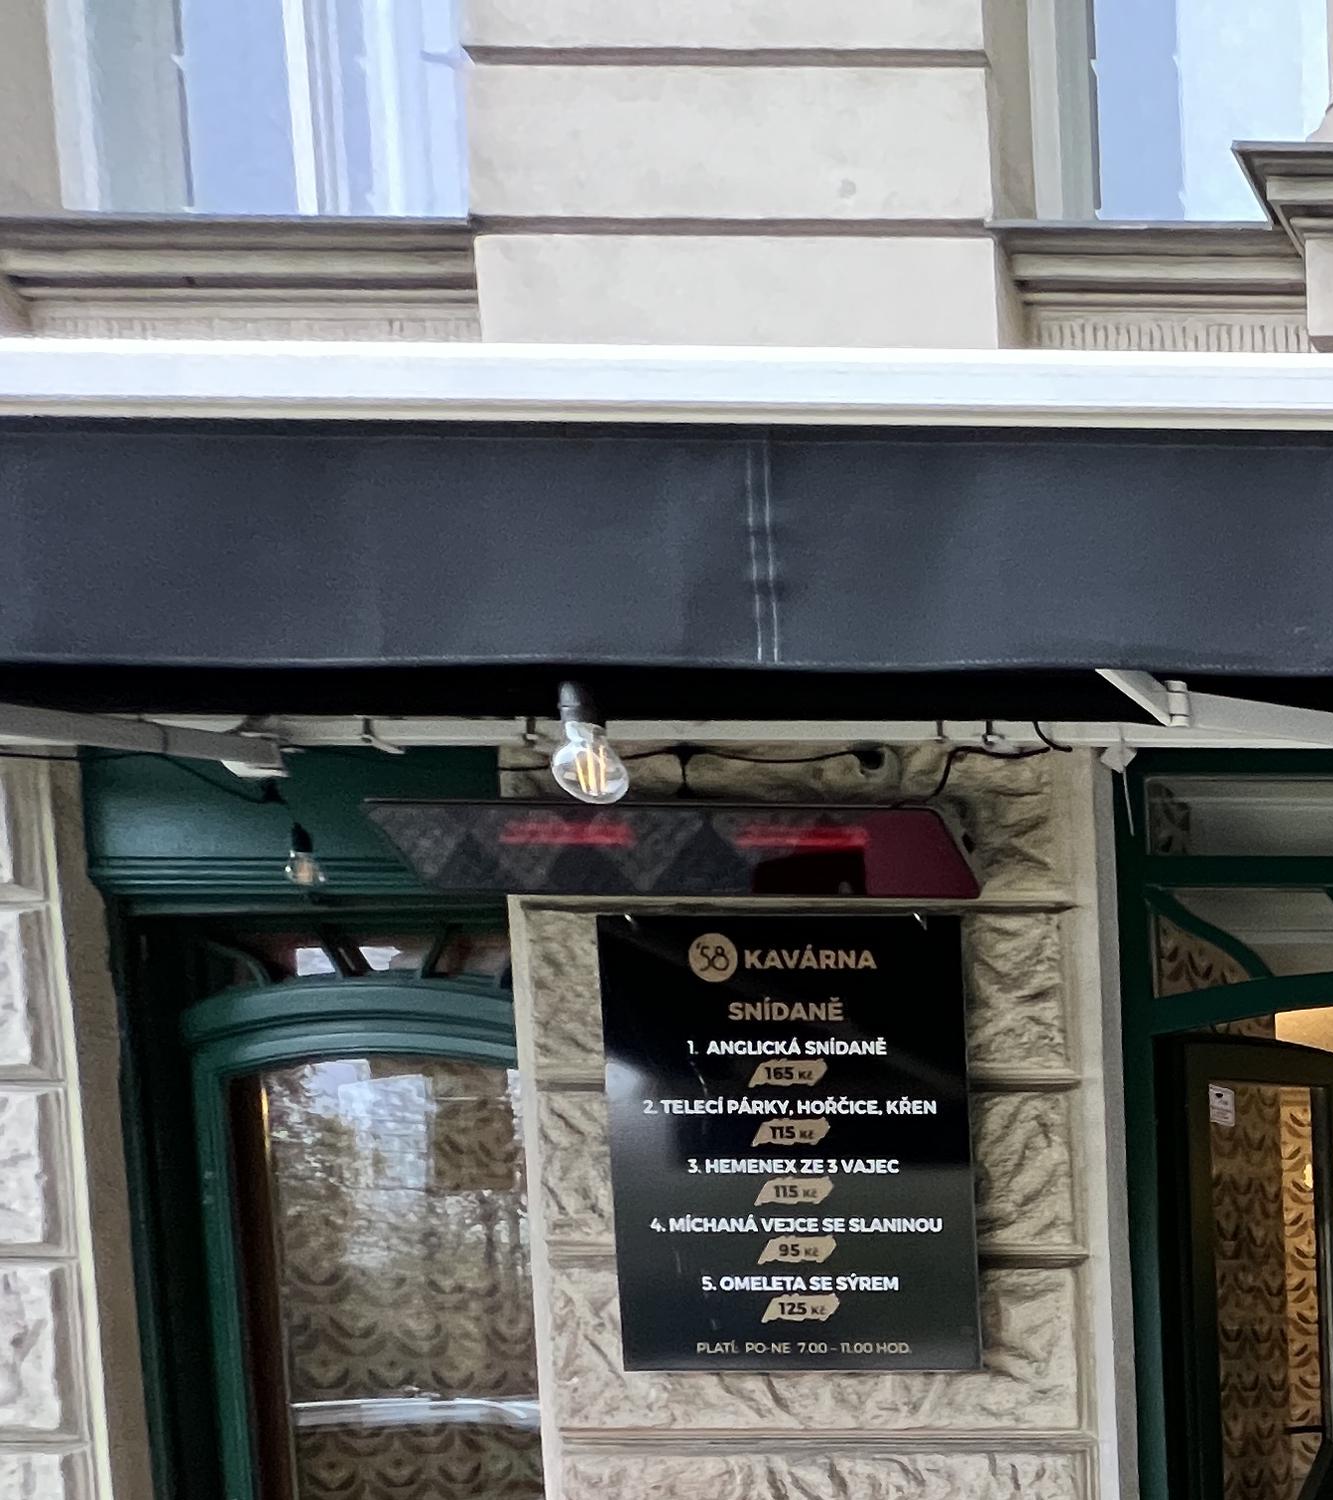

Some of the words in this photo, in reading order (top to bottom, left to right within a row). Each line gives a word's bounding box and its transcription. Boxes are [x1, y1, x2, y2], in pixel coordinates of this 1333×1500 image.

[744, 943, 878, 971] KAVÁRNA
[727, 997, 844, 1022] SNÍDANĚ
[706, 1037, 801, 1056] ANGLICKÁ
[805, 1037, 888, 1056] SNÍDANĚ
[763, 1065, 795, 1081] 165
[660, 1096, 724, 1115] TELECÍ
[886, 1097, 937, 1115] KŘEN
[768, 1124, 796, 1140] 115
[705, 1159, 797, 1174] HEMENEX
[800, 1159, 824, 1174] ZE
[827, 1159, 838, 1174] 3
[840, 1159, 900, 1174] VAJEC
[772, 1183, 798, 1199] 115
[669, 1215, 759, 1233] MÍCHANÁ
[761, 1217, 819, 1233] VEJCE
[822, 1217, 846, 1233] SE
[849, 1217, 943, 1233] SLANINOU
[777, 1243, 800, 1258] 95
[720, 1276, 807, 1292] OMELETA
[809, 1276, 833, 1292] SE
[836, 1273, 900, 1292] SÝREM
[777, 1301, 807, 1316] 125
